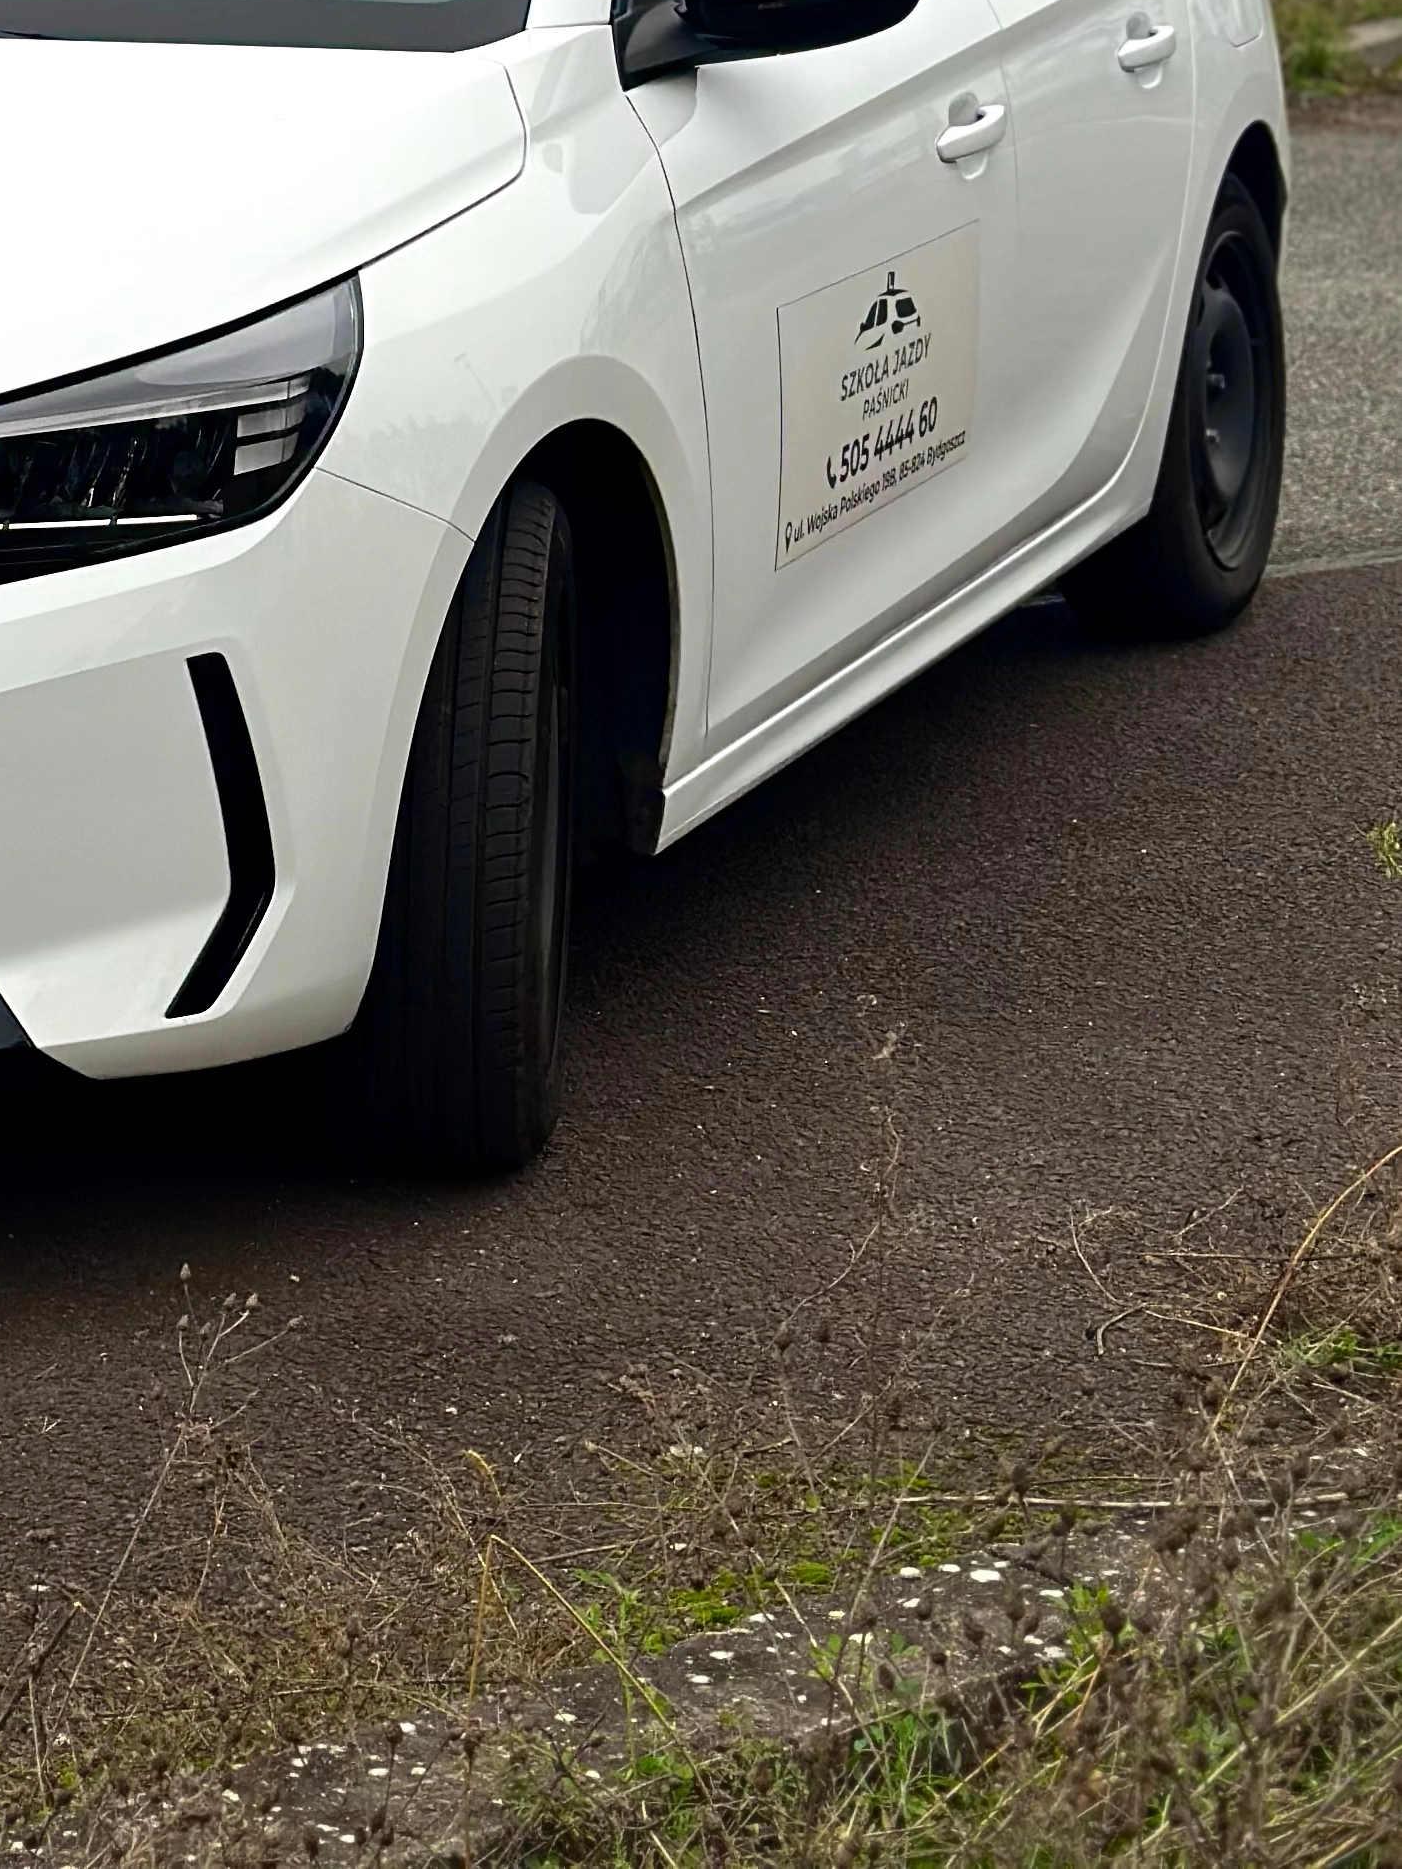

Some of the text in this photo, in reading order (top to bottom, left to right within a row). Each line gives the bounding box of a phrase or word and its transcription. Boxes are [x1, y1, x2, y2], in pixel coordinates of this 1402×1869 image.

[840, 333, 932, 401] SZKOŁA JAZDY
[862, 378, 909, 420] PAŚNICKI
[839, 396, 938, 483] 505 4444 60
[794, 520, 805, 543] ul.
[807, 503, 838, 533] Wojska
[839, 483, 880, 517] Polskiego
[926, 430, 966, 467] Bydgoszcz
